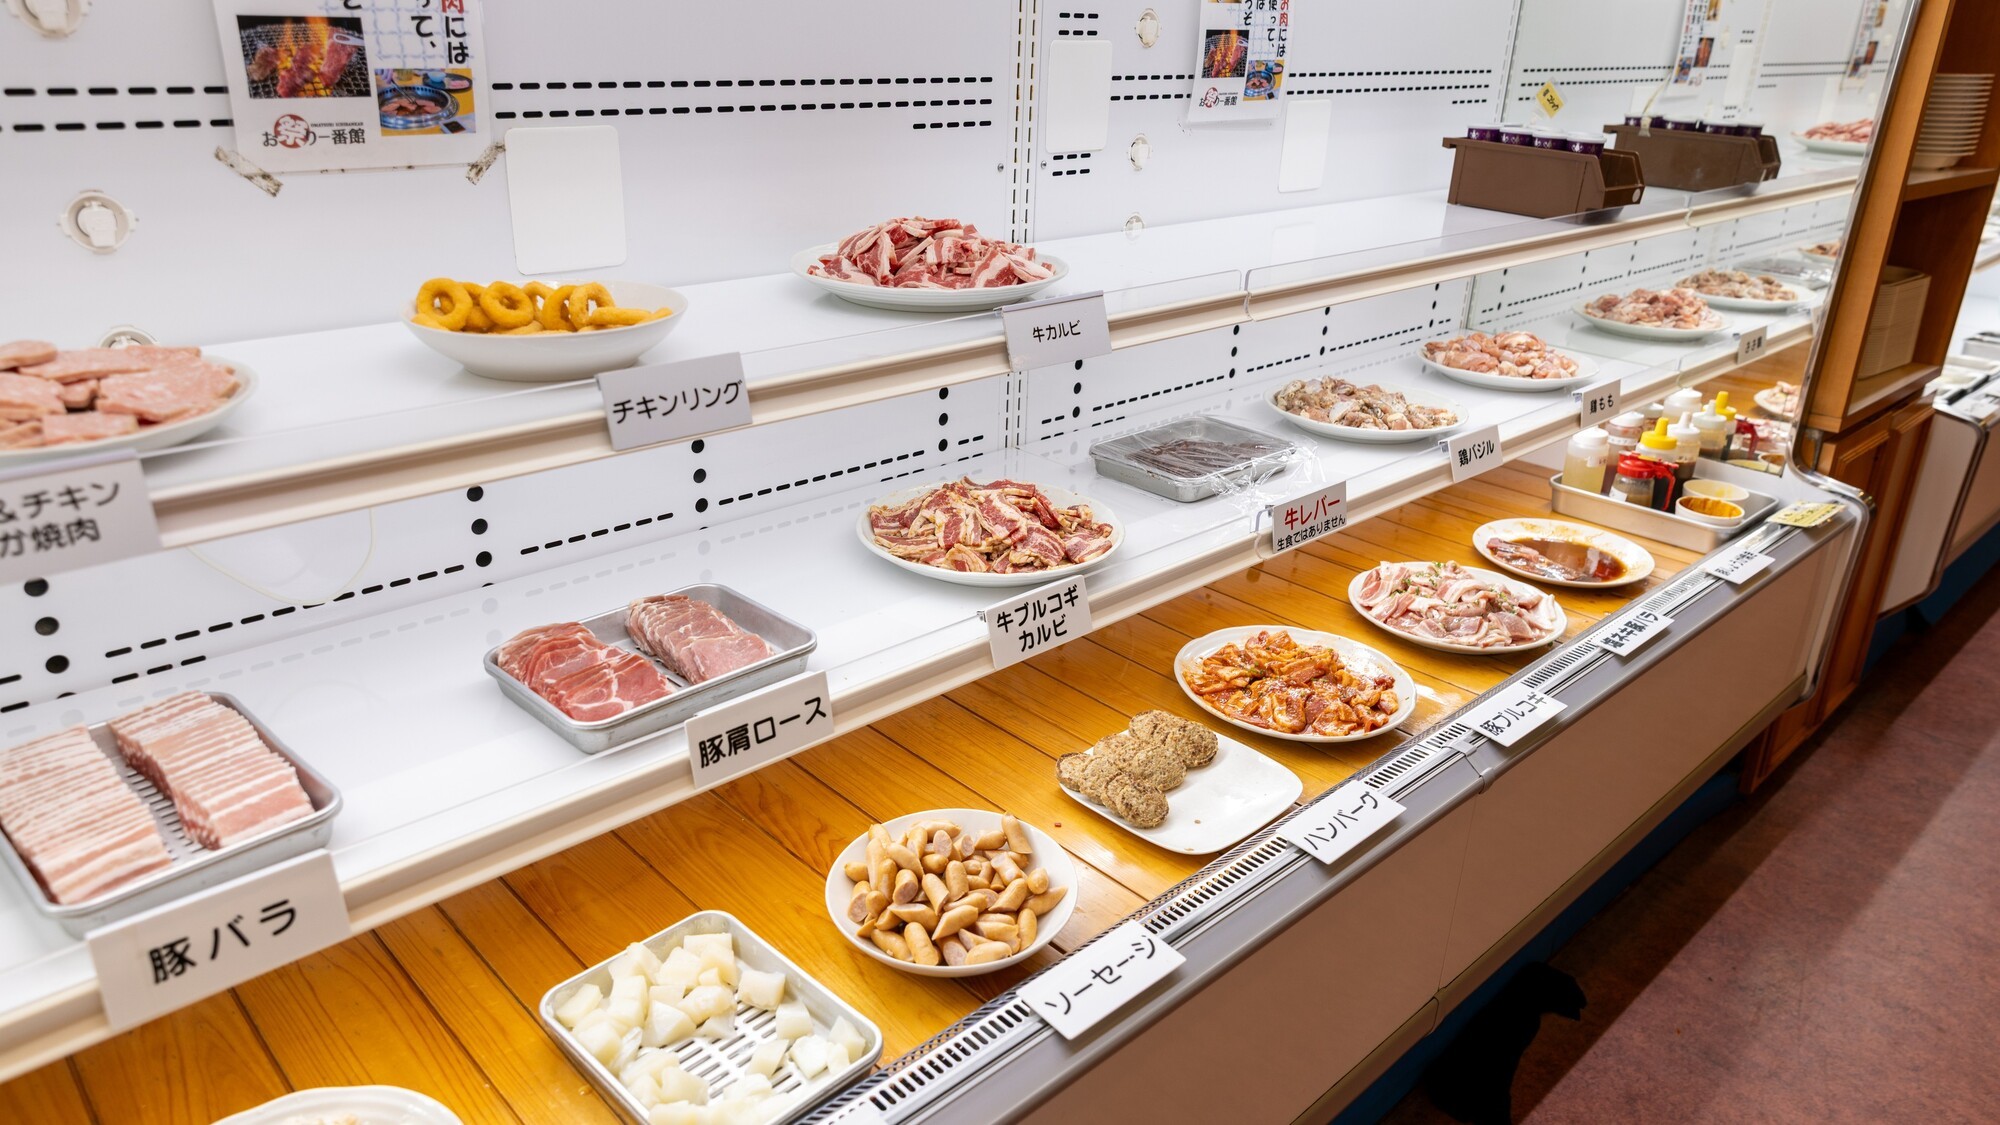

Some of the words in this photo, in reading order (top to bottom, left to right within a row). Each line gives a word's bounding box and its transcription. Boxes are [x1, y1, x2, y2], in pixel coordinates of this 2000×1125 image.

[1032, 320, 1081, 343] 牛カルビ
[613, 379, 743, 424] チキンリング
[1590, 393, 1614, 415] 鶏もも
[1458, 440, 1495, 467] 鶏バジル
[1277, 514, 1346, 551] 生食ではありません
[1284, 495, 1340, 531] 牛レバー
[997, 584, 1079, 633] 牛ブルコギ
[1018, 613, 1068, 652] カルビ
[698, 696, 827, 769] 豚肩ロース
[1479, 691, 1547, 736] 豚ブルコギ
[1303, 791, 1378, 850] ハンバーグ
[148, 898, 297, 985] 豚バラ
[1044, 935, 1156, 1015] ソーセージ
